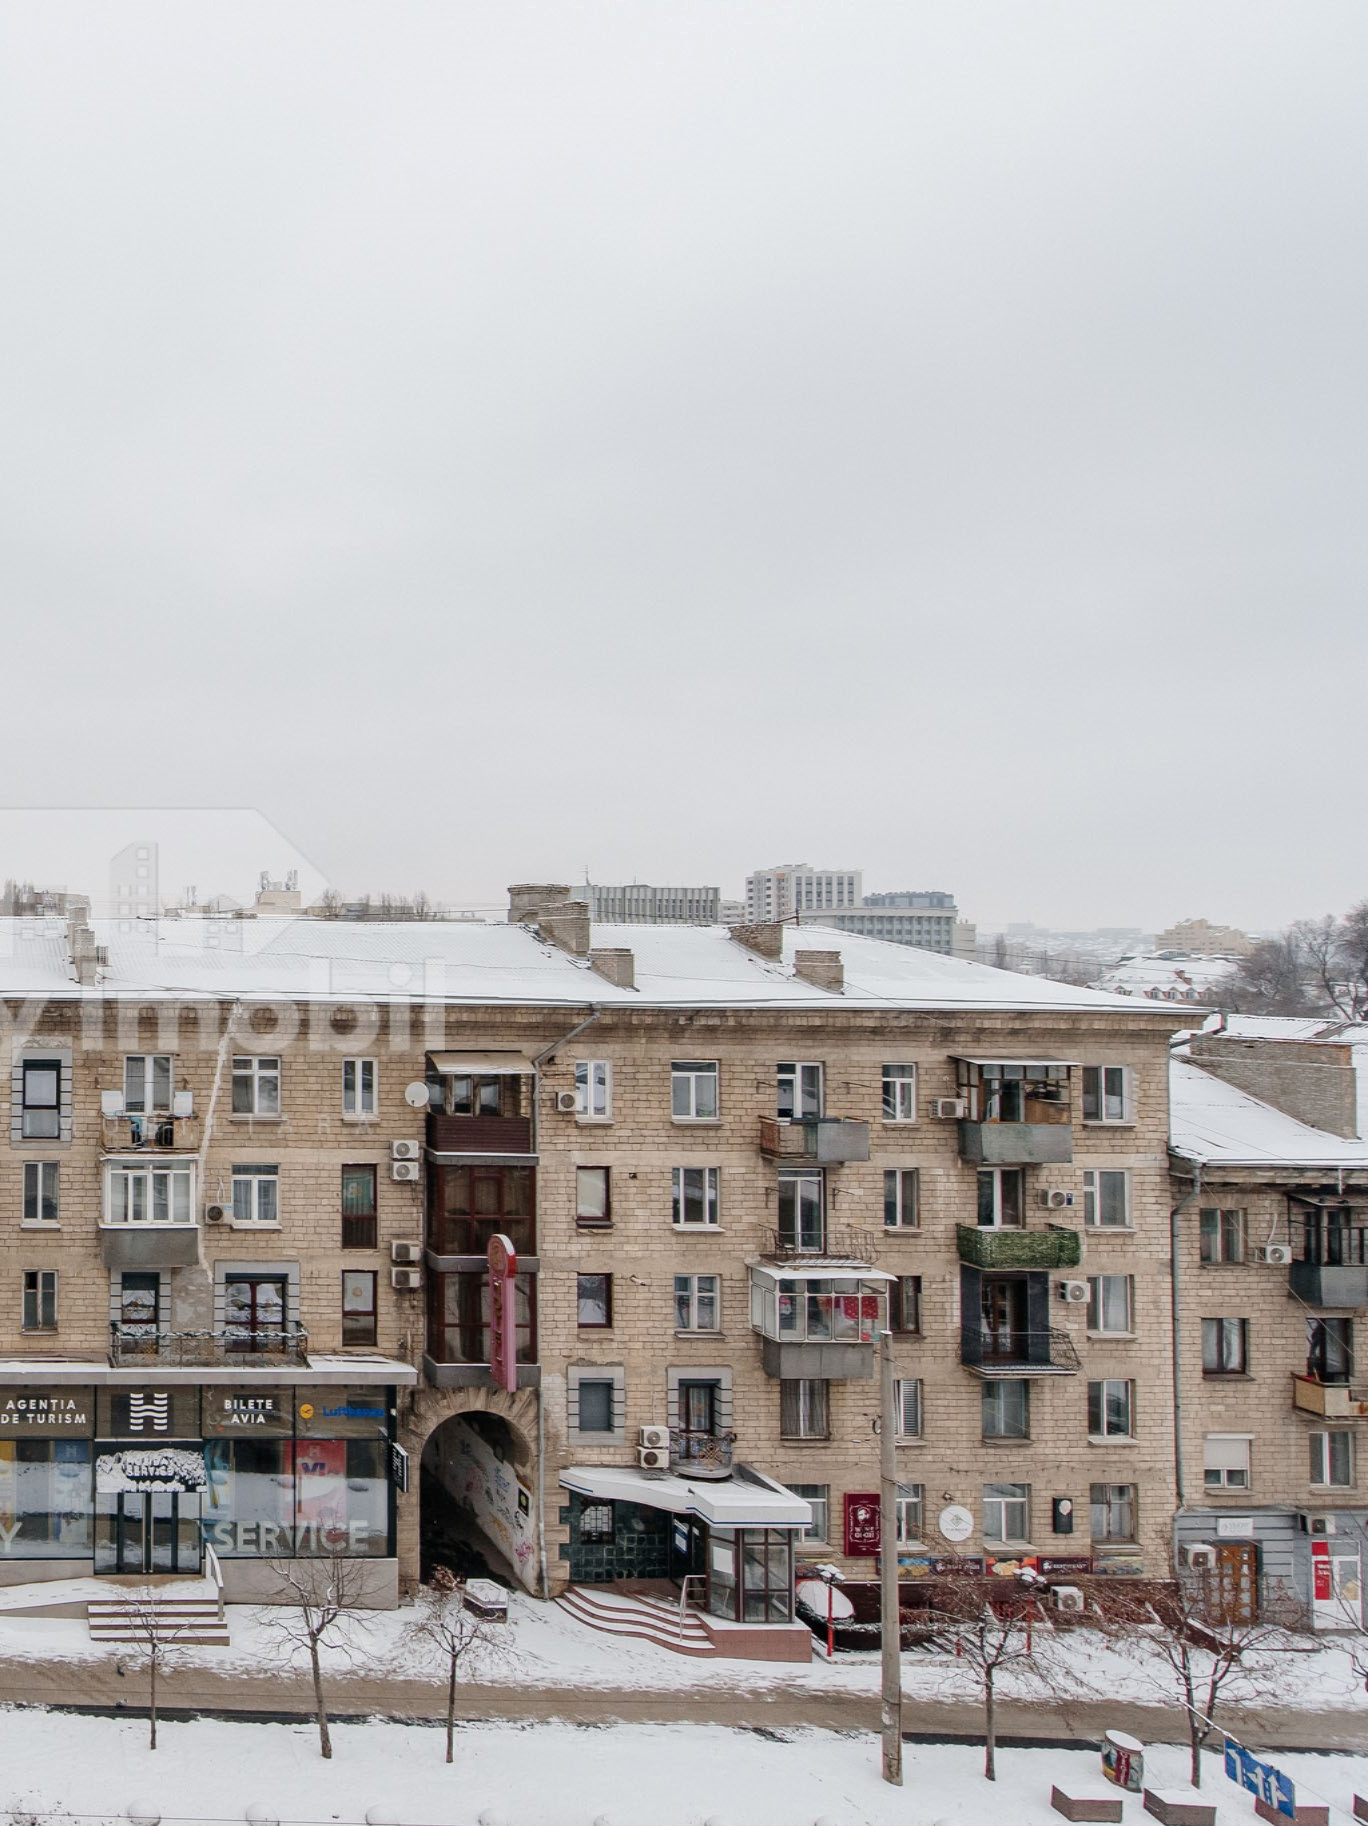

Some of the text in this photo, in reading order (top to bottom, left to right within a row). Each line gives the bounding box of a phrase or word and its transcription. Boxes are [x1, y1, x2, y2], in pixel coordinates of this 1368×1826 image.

[224, 1399, 273, 1409] BILETE
[0, 1414, 87, 1424] DE TURISM
[231, 1414, 266, 1424] AVIA
[214, 1519, 369, 1550] SERVICE
